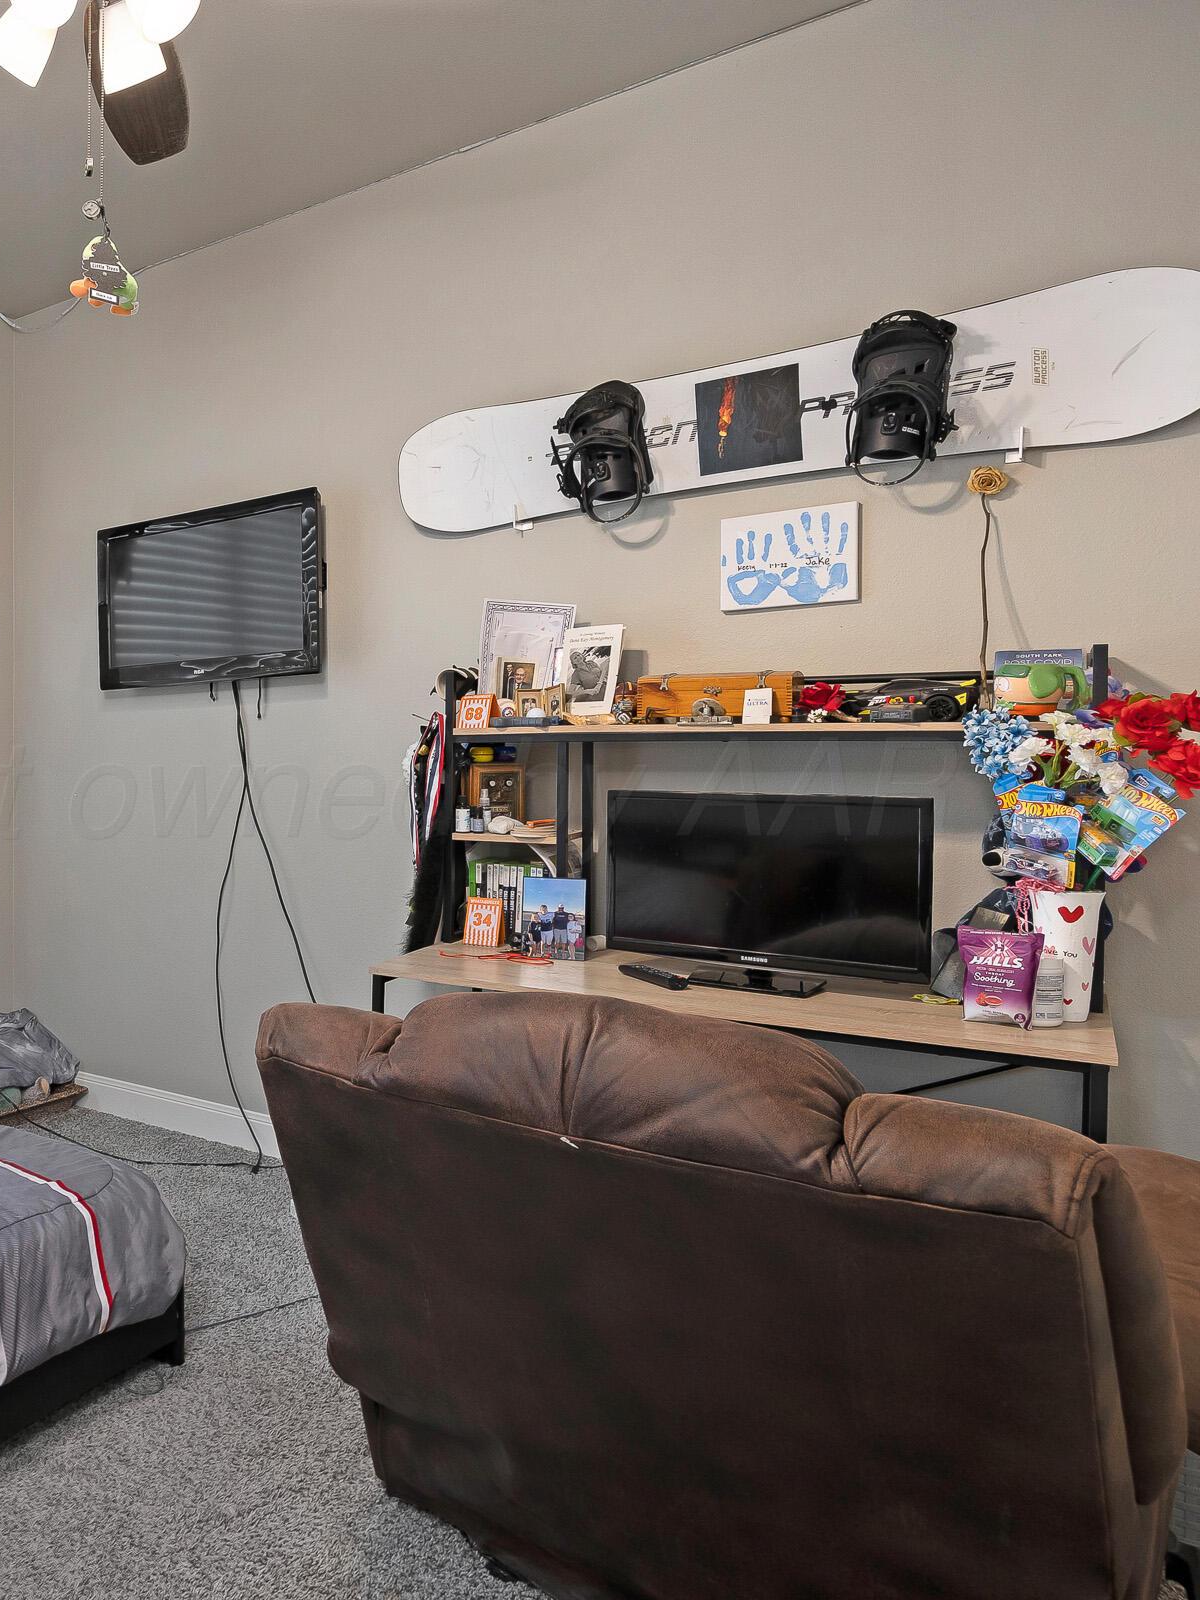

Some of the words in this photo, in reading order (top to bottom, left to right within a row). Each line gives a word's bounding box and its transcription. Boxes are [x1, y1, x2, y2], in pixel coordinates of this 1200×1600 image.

[473, 912, 492, 927] 34
[969, 956, 1023, 969] HALLS
[974, 972, 1015, 987] Soothing
